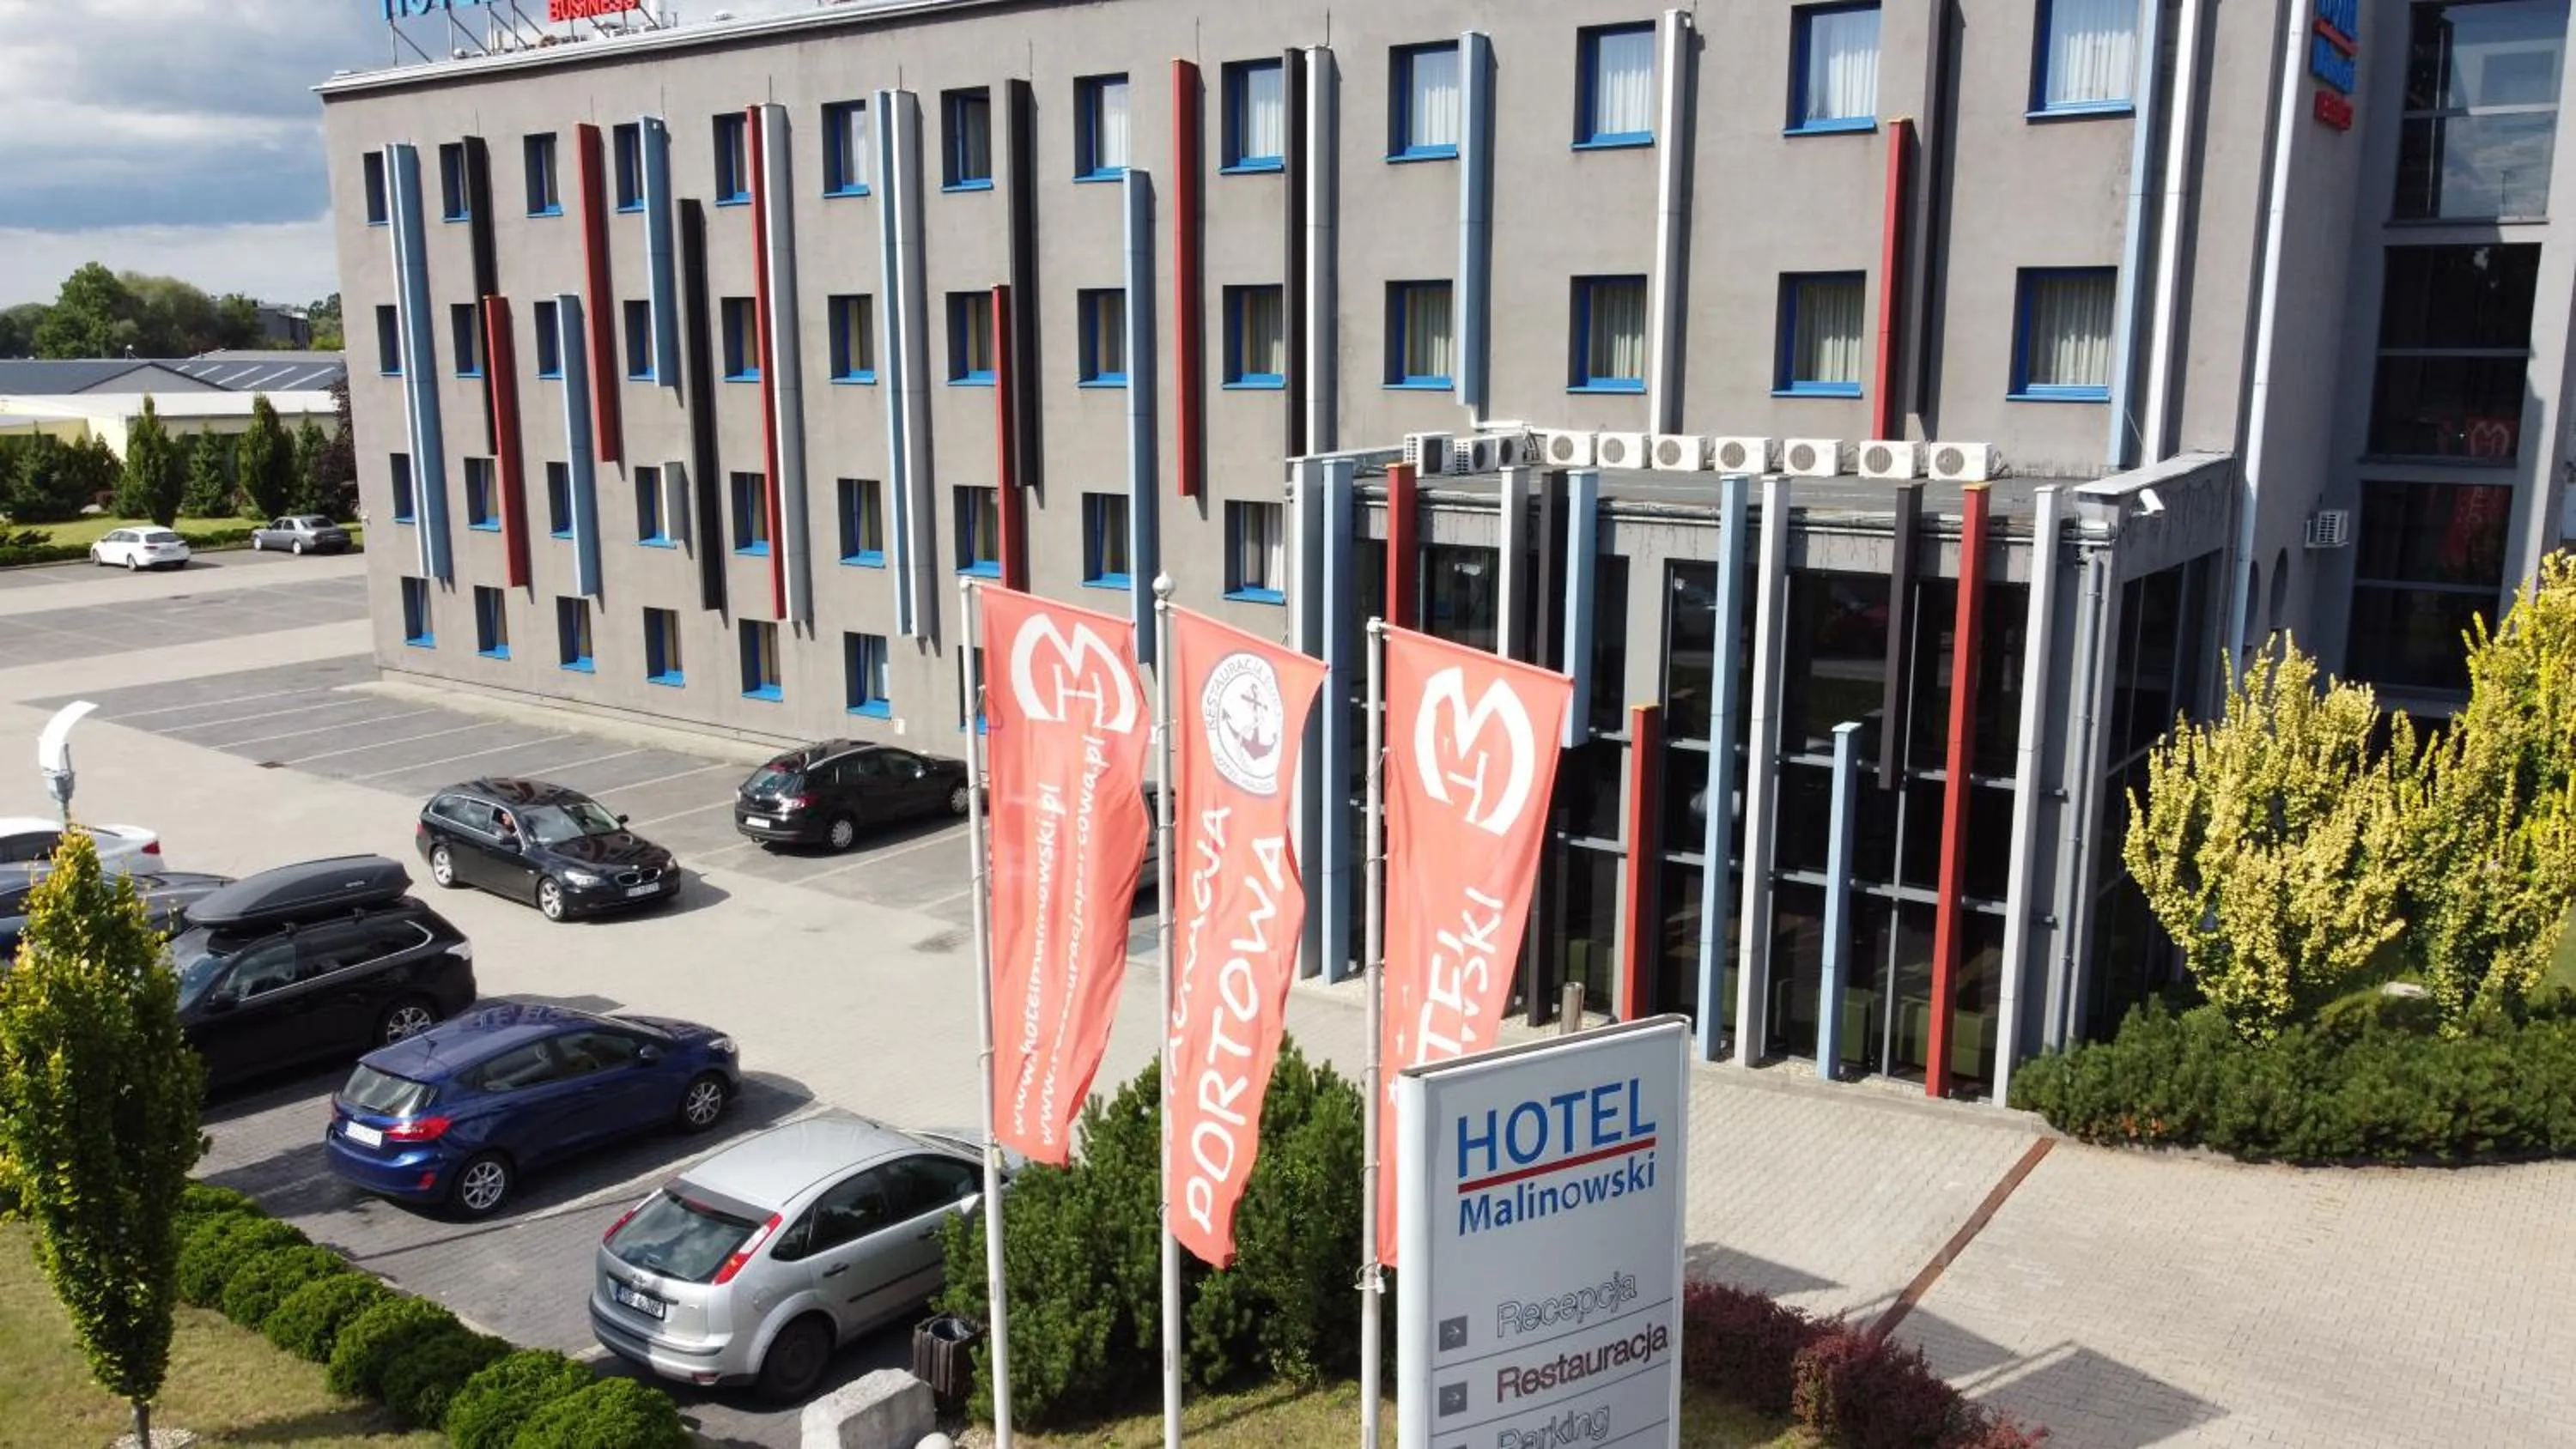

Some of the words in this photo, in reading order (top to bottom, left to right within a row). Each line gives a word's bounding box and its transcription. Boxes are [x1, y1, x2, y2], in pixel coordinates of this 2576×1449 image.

[1188, 836, 1285, 1232] PORTOWA
[1457, 1078, 1656, 1179] HOTEL
[1459, 1152, 1656, 1237] Malinowski
[1497, 1271, 1637, 1338] Recepcja
[1497, 1323, 1668, 1404] Restauracja
[1497, 1405, 1610, 1449] Parking
